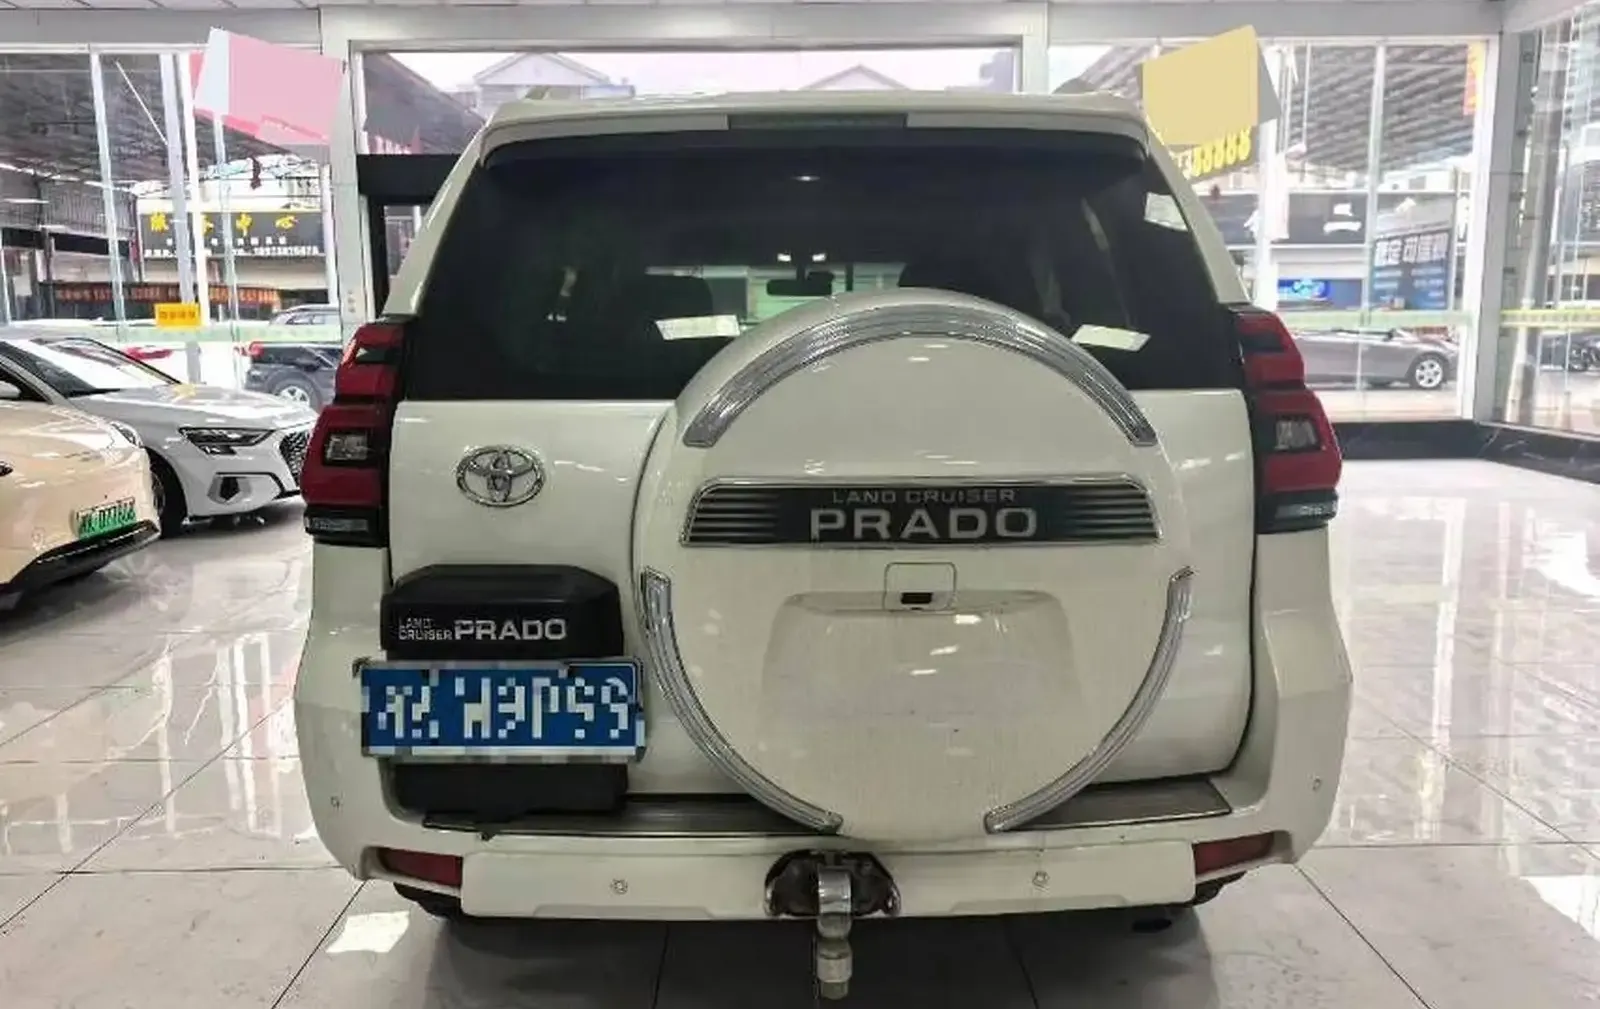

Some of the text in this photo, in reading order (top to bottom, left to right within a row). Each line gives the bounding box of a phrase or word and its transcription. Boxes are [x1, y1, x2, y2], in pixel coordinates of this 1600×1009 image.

[833, 489, 1017, 504] LAND CRUISER
[809, 507, 1038, 539] PRADO
[399, 617, 433, 629] LAND
[455, 619, 567, 641] PRADO
[399, 630, 452, 641] CRUISER
